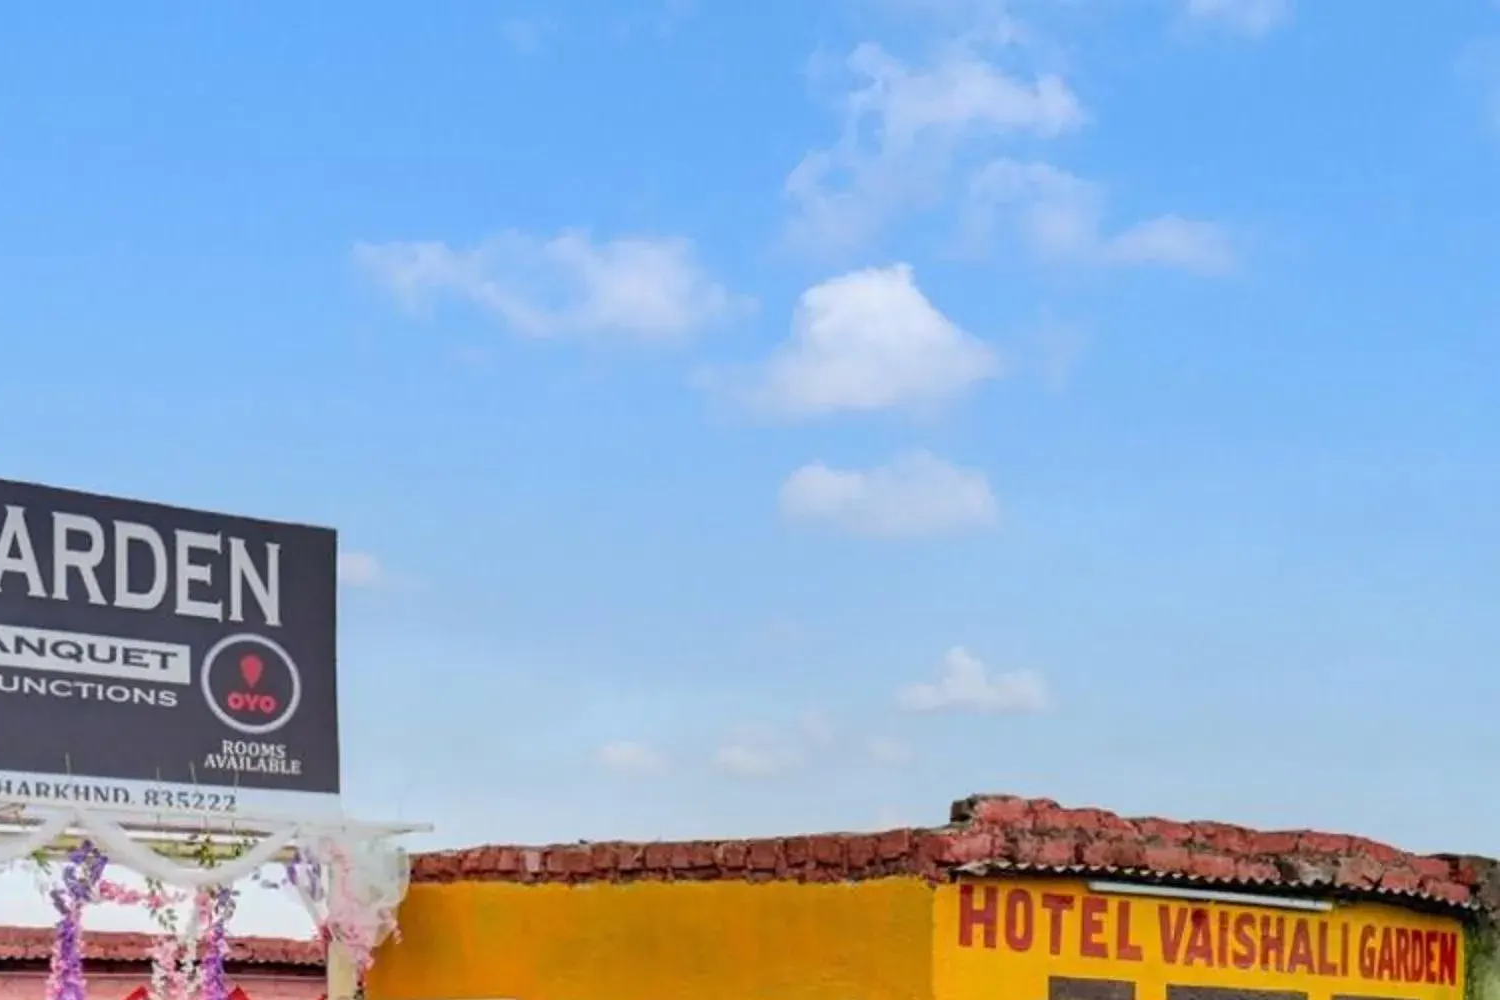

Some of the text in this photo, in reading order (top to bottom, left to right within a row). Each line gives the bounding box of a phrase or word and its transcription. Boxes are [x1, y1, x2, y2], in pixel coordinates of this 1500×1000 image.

[227, 691, 277, 714] OYO
[222, 739, 287, 759] ROOMS
[204, 753, 302, 775] AVAILABLE
[958, 883, 1457, 987] HOTEL VAISHALI GARDEN
